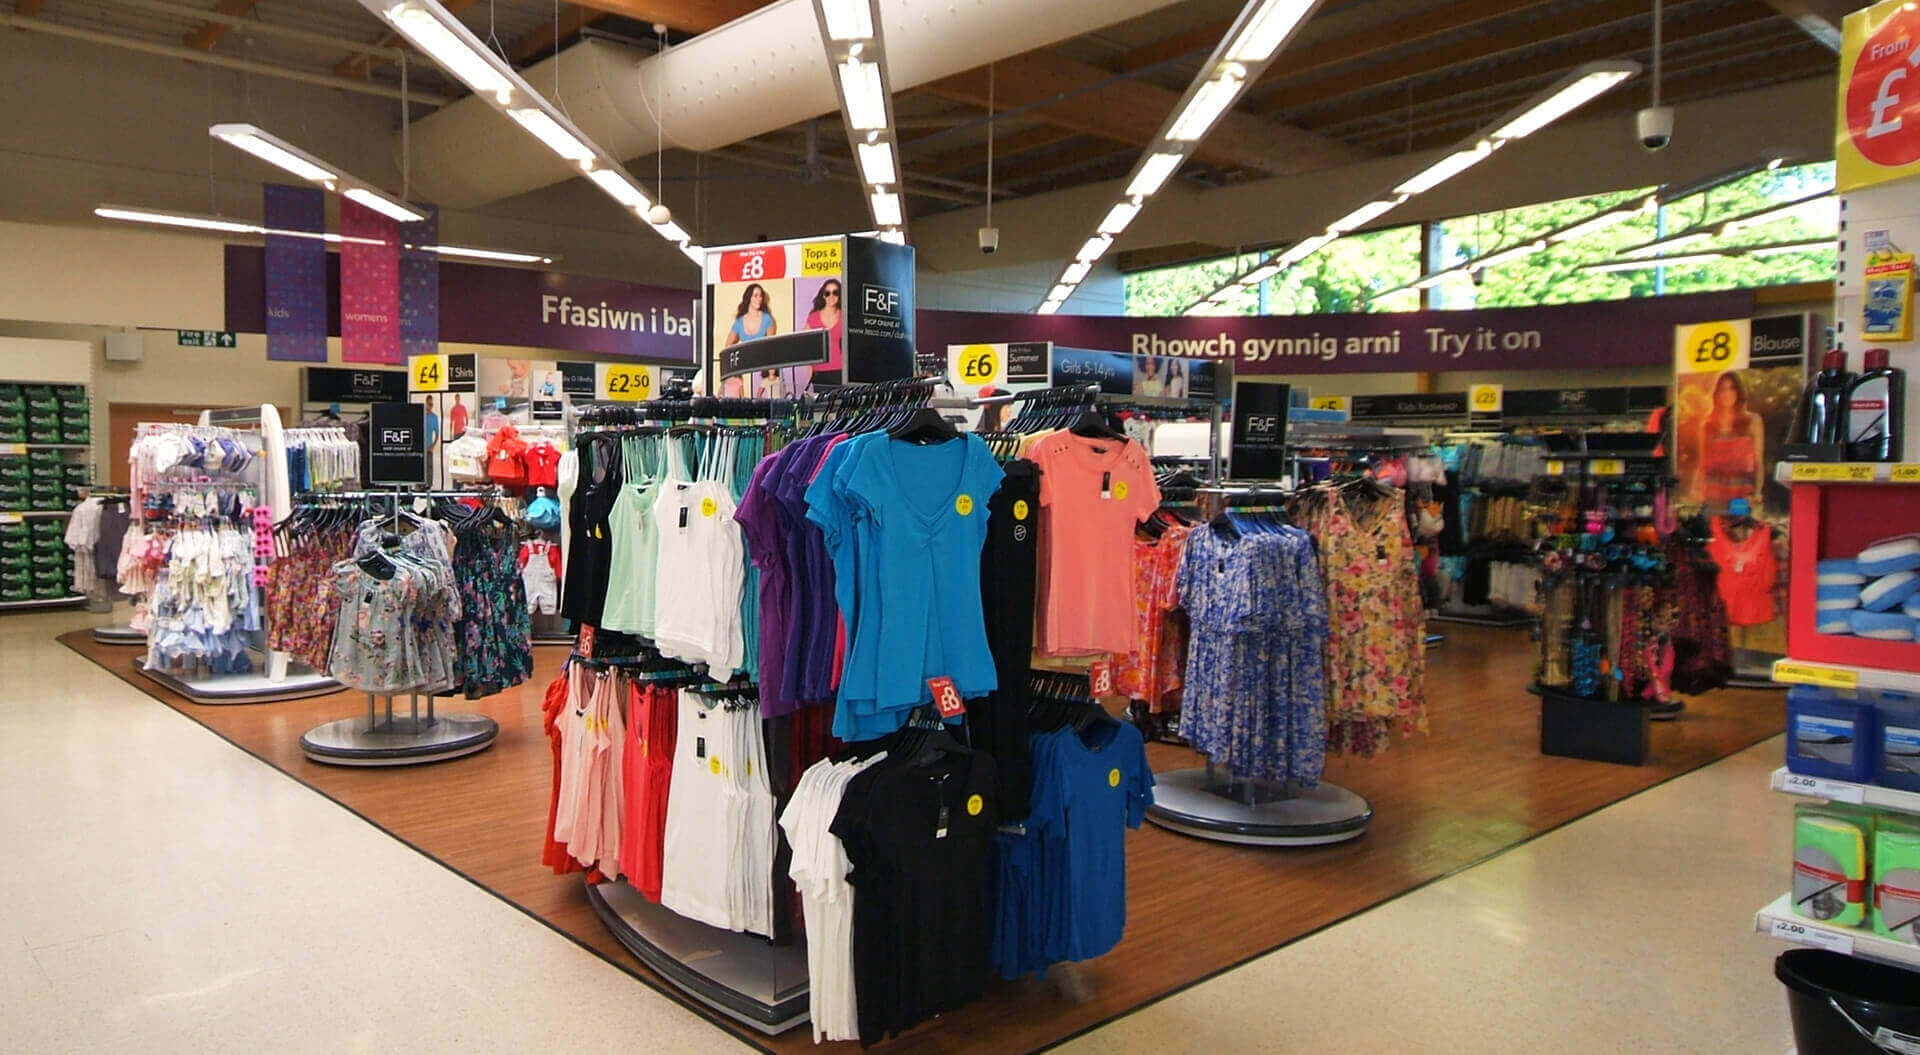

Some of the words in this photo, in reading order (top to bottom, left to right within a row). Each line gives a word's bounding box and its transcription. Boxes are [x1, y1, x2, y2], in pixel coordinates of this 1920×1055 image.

[1871, 36, 1911, 60] From
[805, 248, 828, 260] Tops
[830, 247, 837, 257] &
[741, 255, 764, 280] £8
[865, 288, 899, 314] F&F
[267, 305, 290, 319] kids
[345, 311, 388, 323] womens
[542, 294, 644, 333] Ffasiwn
[651, 307, 657, 333] i
[1132, 332, 1235, 357] Rhowch
[1243, 332, 1337, 362] gynnig
[1345, 330, 1400, 355] arni
[1425, 327, 1468, 358] Try
[1476, 327, 1495, 351] it
[1503, 329, 1541, 349] on
[1695, 327, 1731, 364] £8
[1753, 334, 1801, 352] Blouse
[965, 354, 992, 377] £6
[1009, 353, 1039, 364] Summer
[1061, 358, 1082, 375] Girls
[353, 373, 380, 386] F&F
[420, 362, 439, 384] £4
[450, 367, 456, 377] T
[456, 366, 474, 378] Shirts
[608, 373, 650, 393] £2.50
[1248, 416, 1276, 433] F&F
[383, 430, 410, 444] F&F
[1095, 670, 1110, 693] £8
[941, 686, 960, 712] £8
